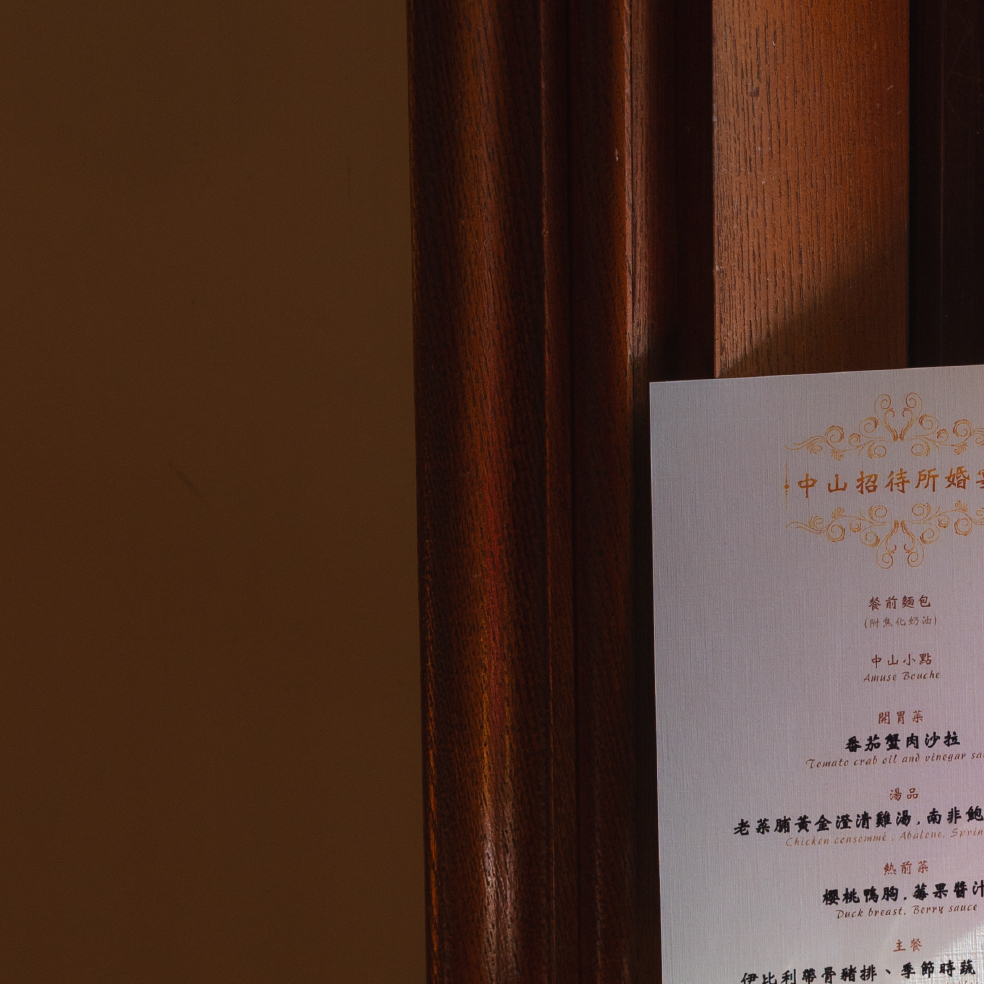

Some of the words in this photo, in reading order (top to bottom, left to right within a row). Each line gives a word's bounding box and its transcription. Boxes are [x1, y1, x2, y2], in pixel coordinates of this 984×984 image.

[868, 594, 931, 611] 餐前麵包
[870, 652, 932, 669] 中山小點
[863, 673, 897, 683] Amuse
[902, 670, 940, 681] Bouche
[878, 710, 924, 725] 開胃菜
[845, 730, 961, 752] 番茄蟹肉沙拉
[805, 758, 849, 769] Tomato
[853, 757, 878, 766] crab
[882, 754, 898, 765] oil
[902, 753, 920, 763] and
[925, 752, 966, 763] vinegar
[889, 787, 919, 801] 湯品
[785, 836, 830, 847] Chicken
[883, 860, 928, 875] 熱前菜
[836, 908, 863, 919] Duck
[913, 904, 944, 915] Berry
[949, 903, 977, 912] sauce
[893, 938, 922, 952] 主餐
